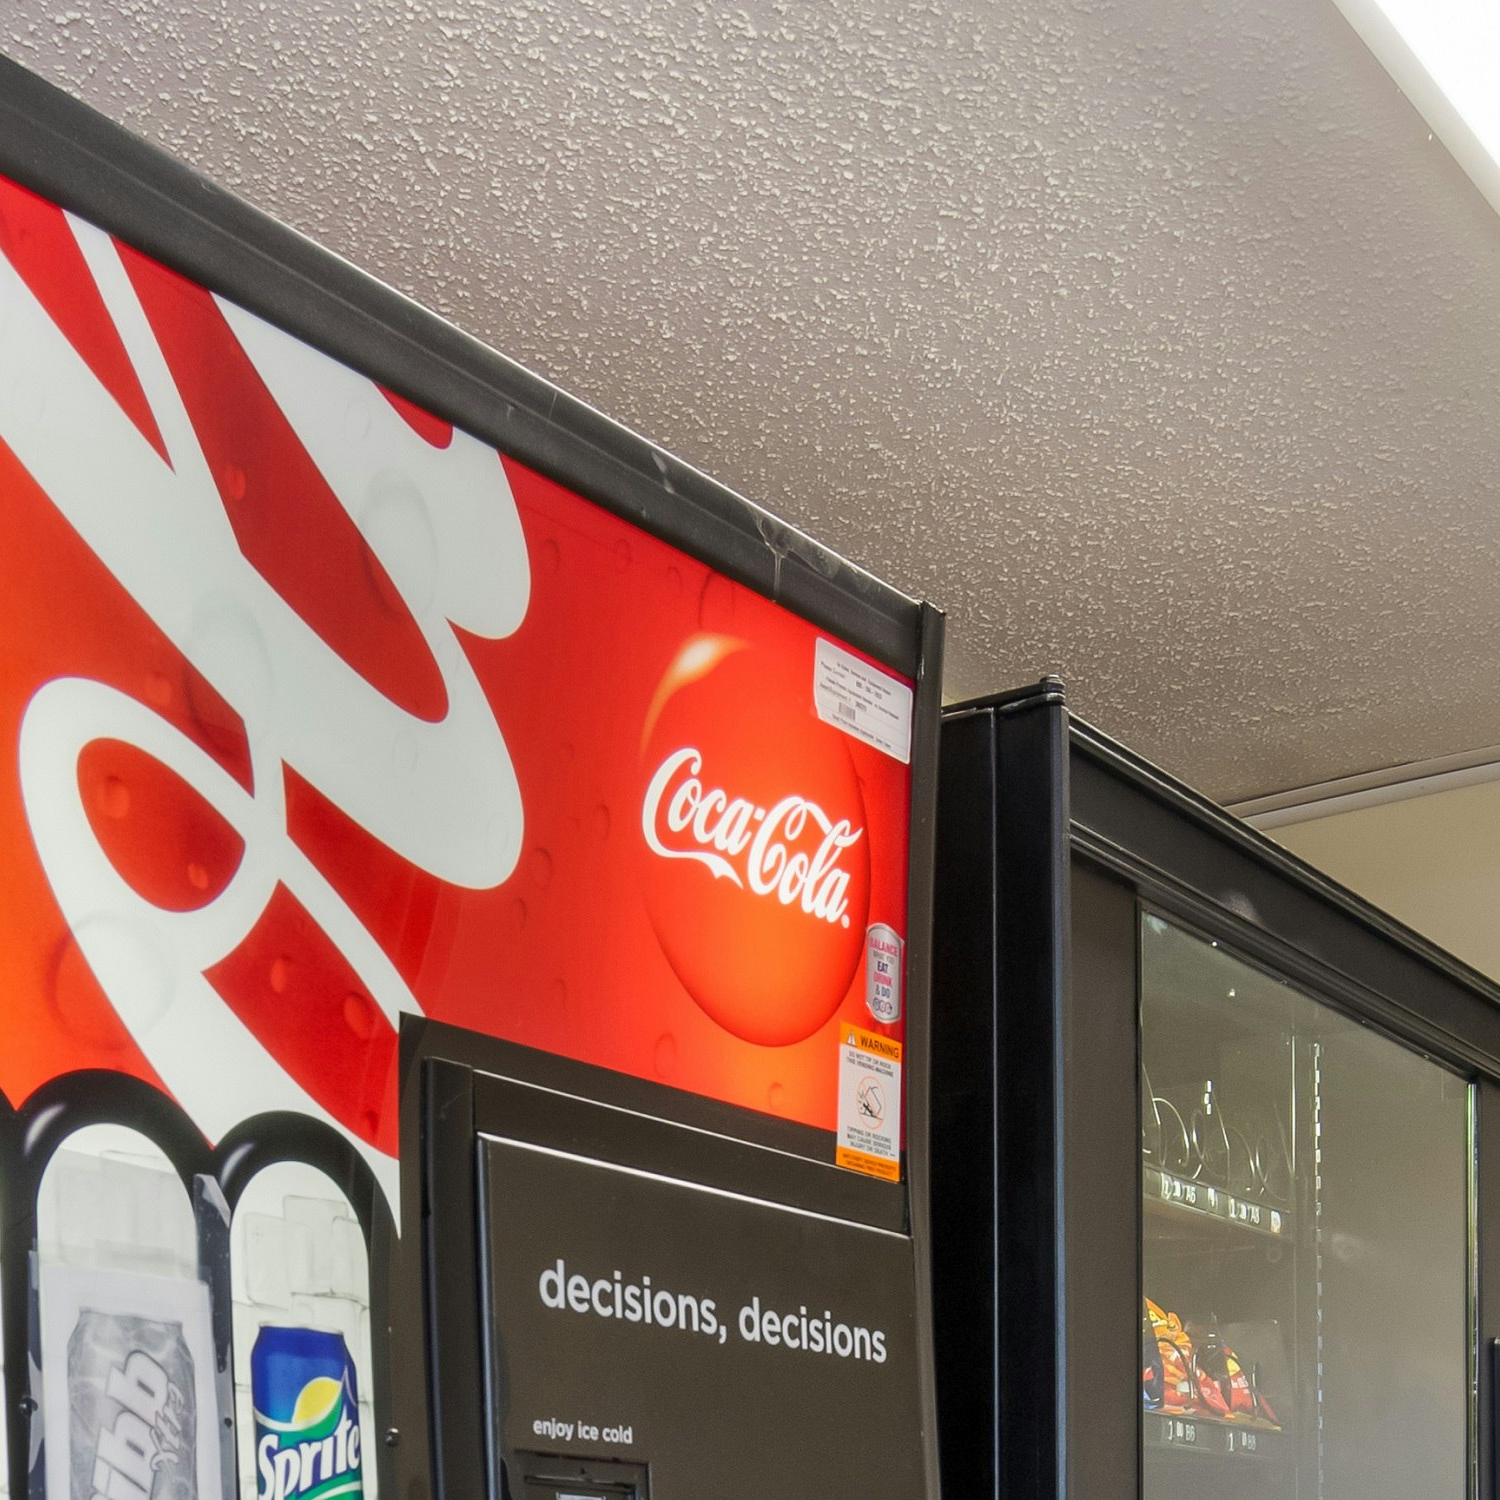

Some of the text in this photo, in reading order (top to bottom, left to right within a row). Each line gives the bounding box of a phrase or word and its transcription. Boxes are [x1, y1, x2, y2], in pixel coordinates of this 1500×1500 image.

[642, 747, 864, 928] Coca-Cola
[877, 960, 888, 973] EAT
[860, 1034, 899, 1058] WARNING
[539, 1259, 887, 1364] decisions, decisions
[533, 1417, 633, 1444] enjoy ice cold
